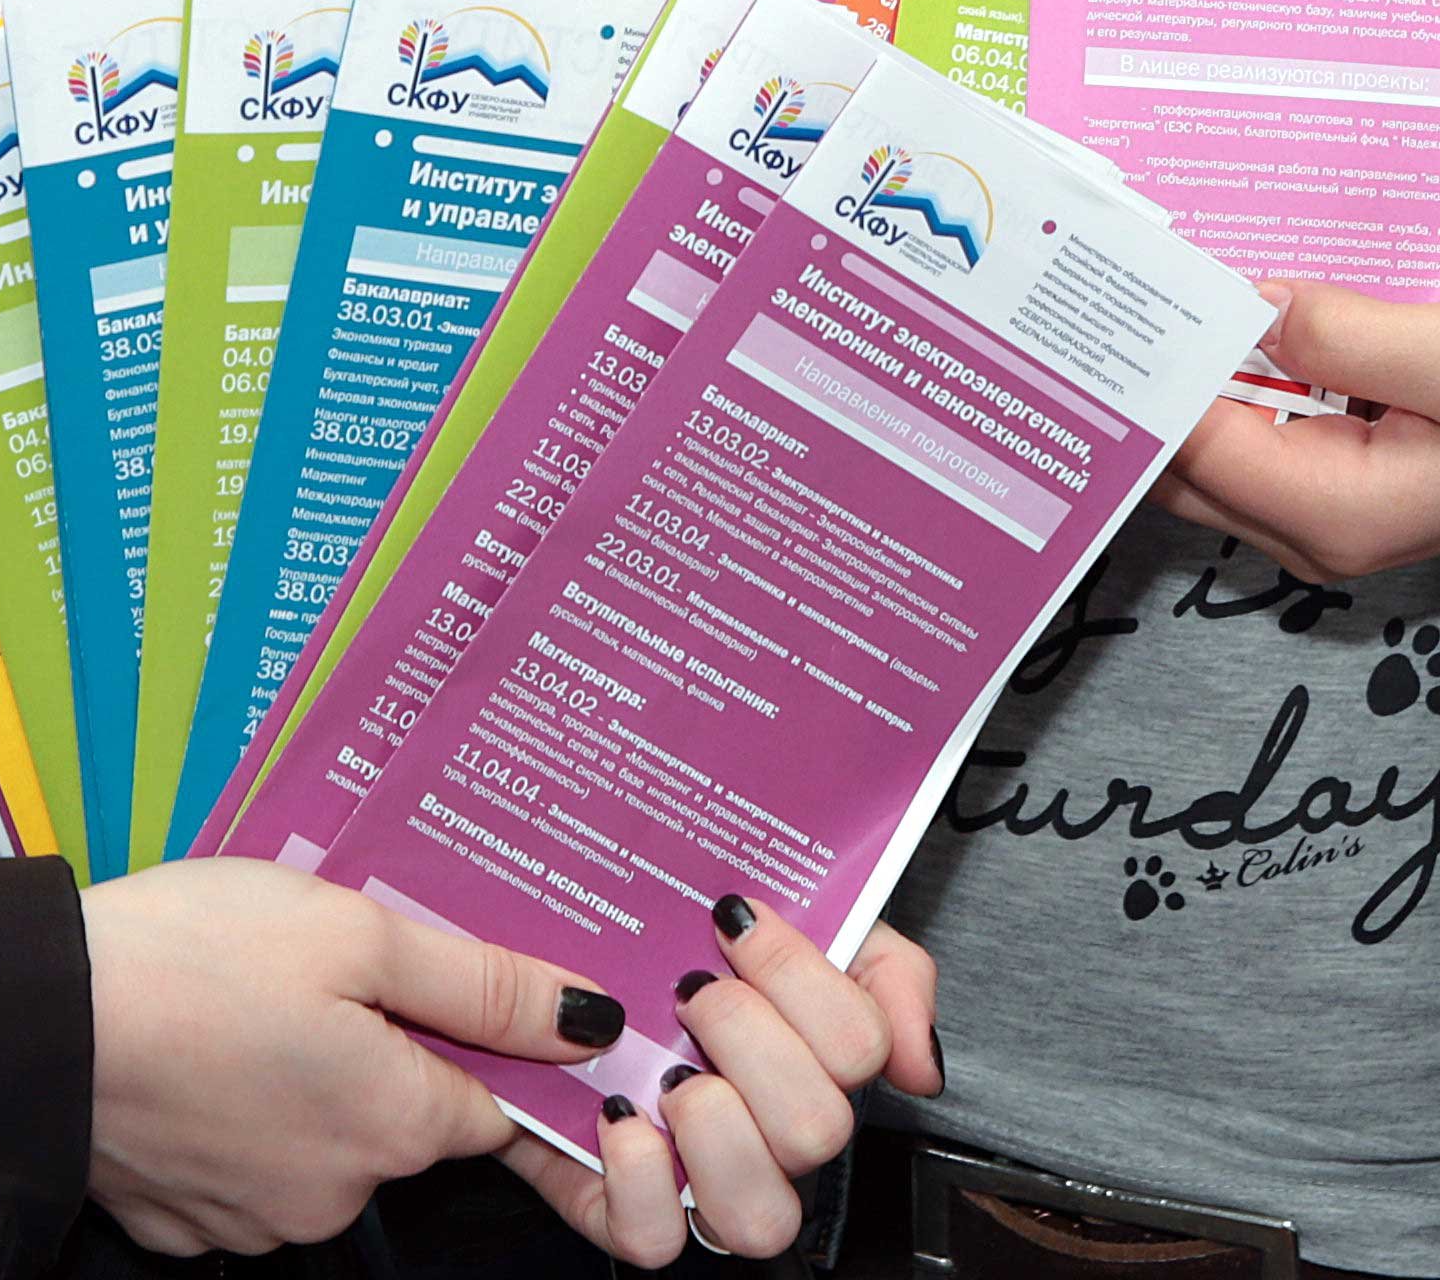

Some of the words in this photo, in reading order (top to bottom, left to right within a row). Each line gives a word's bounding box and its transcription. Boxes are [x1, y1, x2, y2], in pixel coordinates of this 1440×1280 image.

[1085, 27, 1095, 36] и
[1096, 27, 1117, 38] его
[1119, 28, 1192, 42] результатов.
[386, 82, 470, 114] СКФУ
[1117, 53, 1135, 78] В
[1137, 59, 1200, 82] лицее
[1203, 62, 1335, 90] реализуются
[1339, 67, 1429, 93] проекты:
[75, 107, 158, 145] СКФУ
[240, 95, 323, 121] СКФУ
[409, 159, 537, 204] Институт
[728, 128, 802, 179] СКФУ
[401, 198, 421, 218] и
[834, 194, 909, 246] СКФУ
[336, 299, 433, 331] 38.03.01
[342, 277, 470, 310] Бакалавриат:
[770, 287, 904, 377] электроники
[902, 368, 922, 388] и
[920, 379, 1091, 493] нанотехнологий
[797, 263, 896, 334] Институт
[892, 326, 1091, 465] электроэнергетики,
[700, 383, 809, 459] Бакалавриат:
[793, 355, 912, 438] Направления
[910, 430, 1010, 499] подготовки
[614, 513, 652, 541] ческий
[649, 533, 720, 582] бакалавриат)
[624, 493, 710, 551] 11.03.04
[770, 466, 872, 534] Электроэнергетика
[870, 528, 882, 540] и
[879, 534, 963, 590] электротехника
[527, 630, 647, 711] Магистратура:
[548, 603, 593, 633] русский
[591, 627, 619, 651] язык,
[620, 644, 684, 690] математика,
[686, 682, 725, 712] физика
[561, 580, 685, 663] Вступительные
[684, 655, 780, 719] испытания:
[510, 656, 598, 717] 13.04.02
[452, 743, 540, 803] 11.04.04
[418, 791, 545, 876] Вступительные
[545, 868, 644, 935] испытания:
[1236, 836, 1366, 889] Colin's
